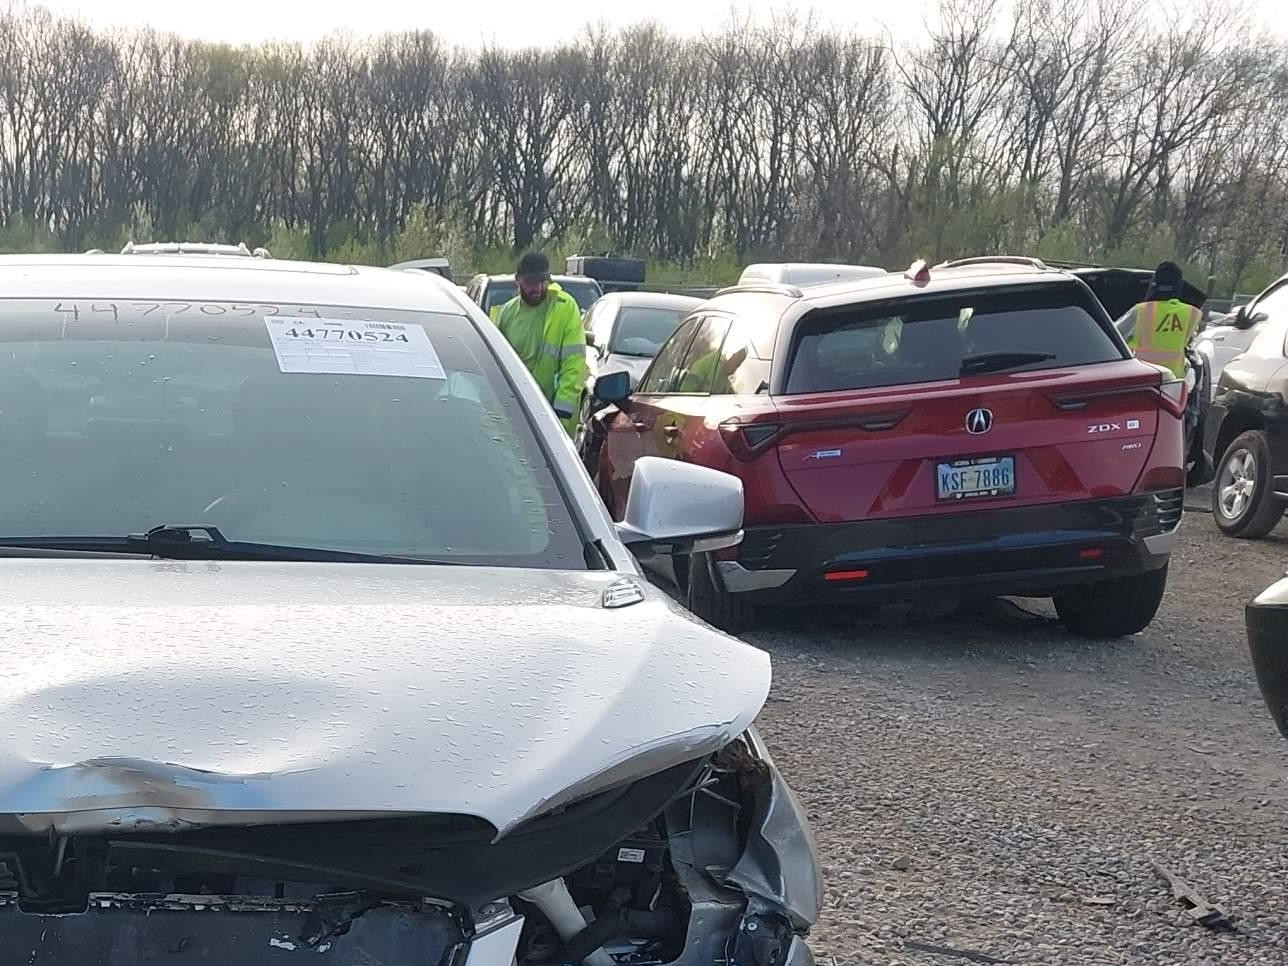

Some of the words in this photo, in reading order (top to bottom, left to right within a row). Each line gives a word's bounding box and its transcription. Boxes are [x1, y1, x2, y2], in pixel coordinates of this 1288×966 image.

[285, 327, 410, 343] 44770524
[1087, 422, 1121, 434] ZDX
[941, 471, 968, 492] KSF
[974, 467, 1010, 489] 7886
